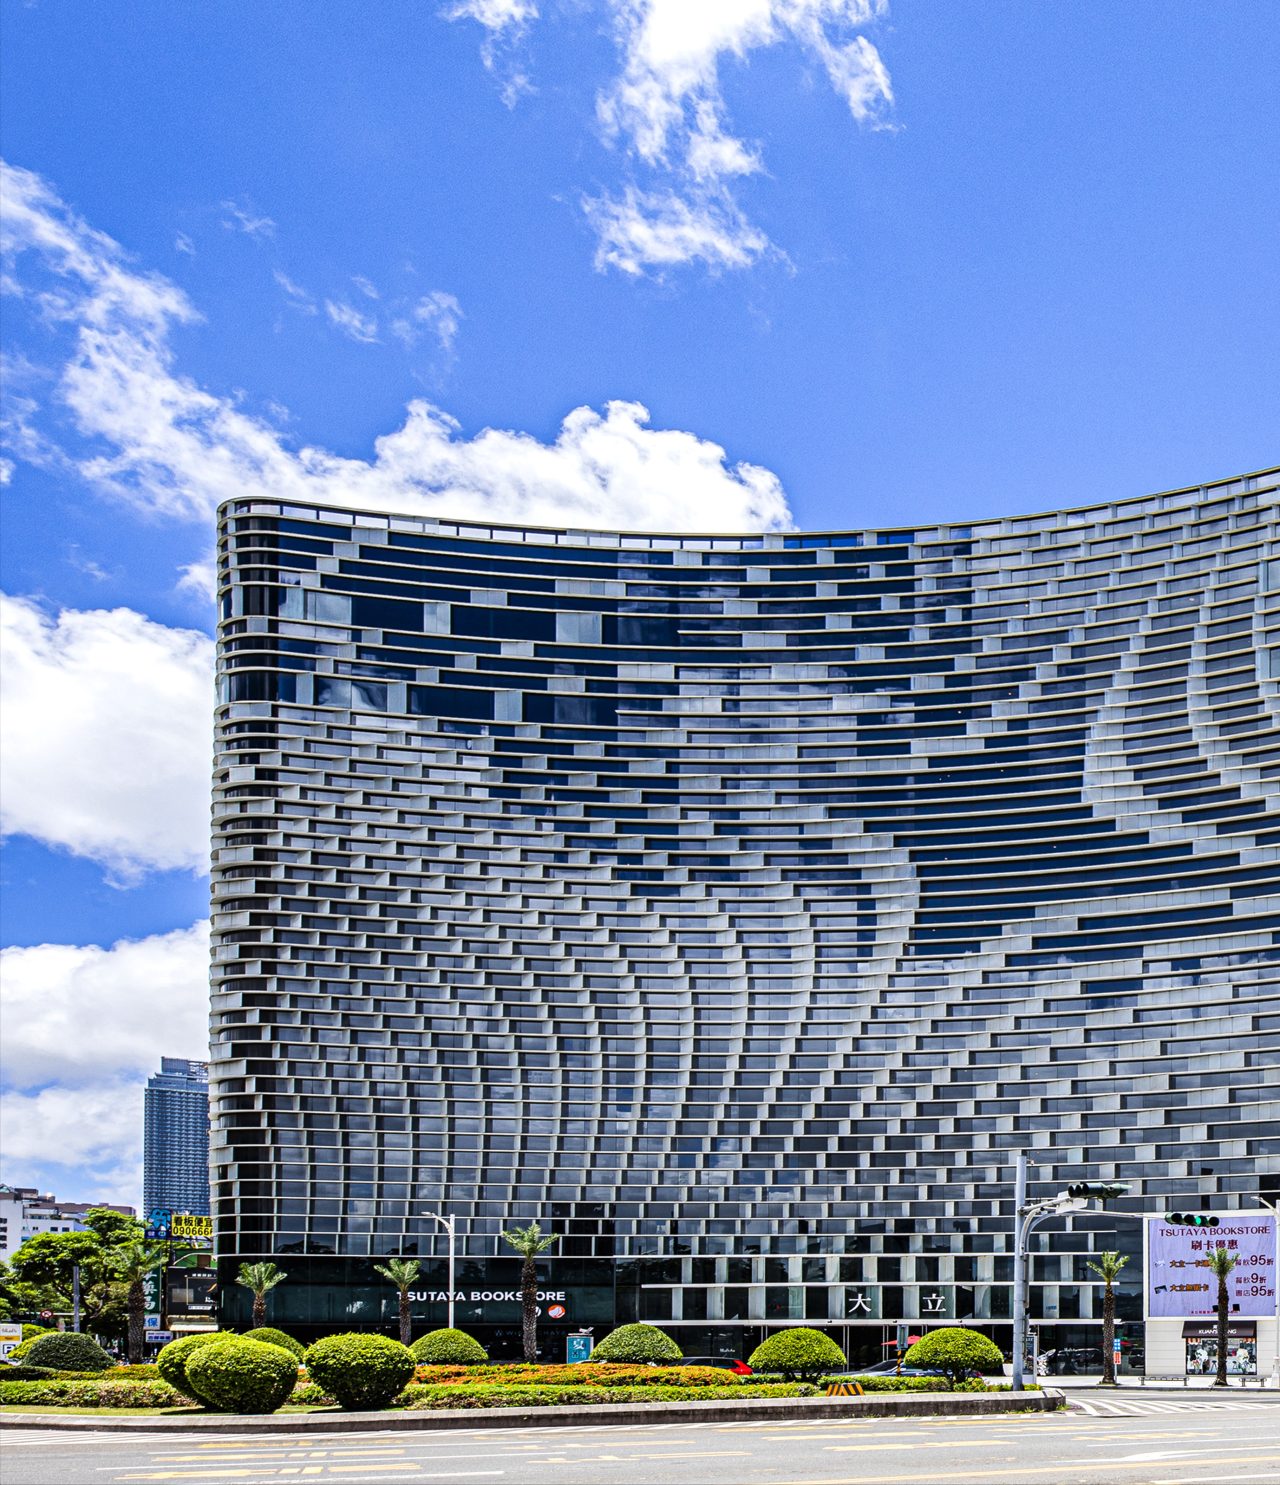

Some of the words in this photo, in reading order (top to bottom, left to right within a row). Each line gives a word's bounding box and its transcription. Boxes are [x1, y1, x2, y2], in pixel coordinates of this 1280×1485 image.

[1159, 1228, 1207, 1237] TSUTAYA
[1210, 1226, 1271, 1236] BOOKSTORE
[1191, 1239, 1239, 1250] 刷卡優惠
[471, 1291, 566, 1301] BOOKSORE
[848, 1293, 947, 1313] 大立
